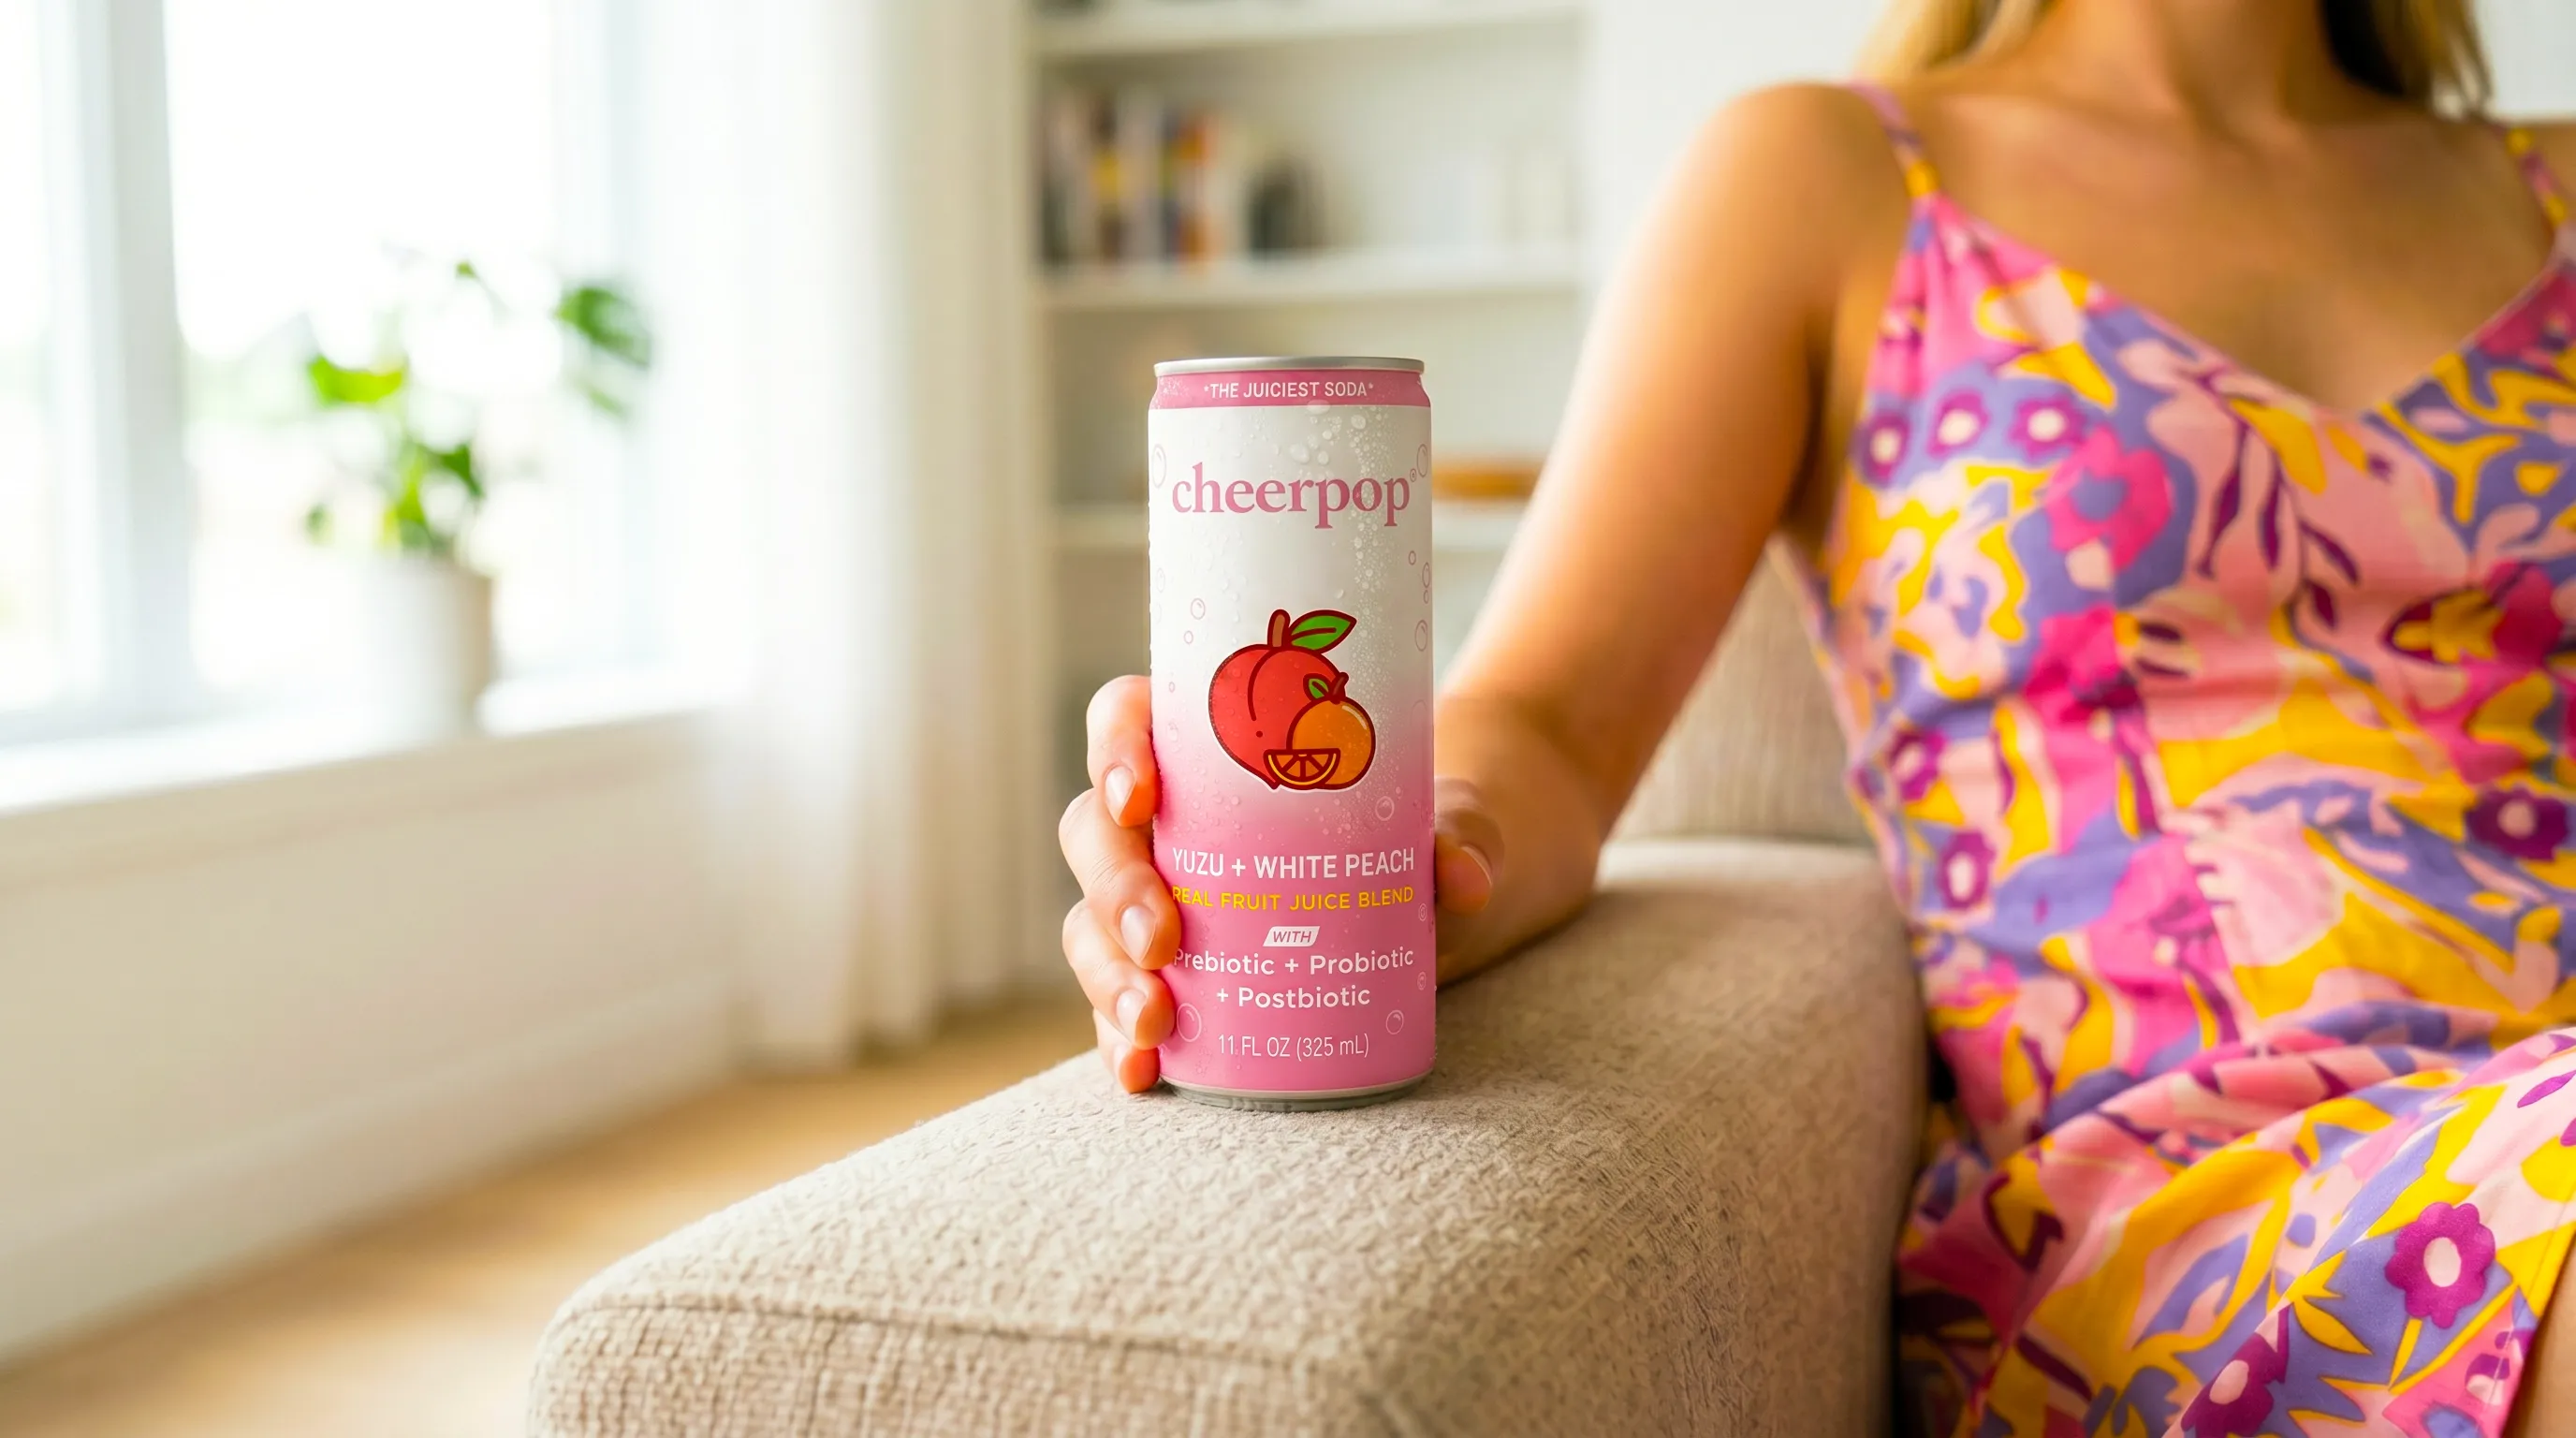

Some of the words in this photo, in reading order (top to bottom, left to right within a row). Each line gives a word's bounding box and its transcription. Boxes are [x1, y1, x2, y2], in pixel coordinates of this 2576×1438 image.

[1243, 382, 1320, 398] JUICIEST
[1172, 847, 1224, 877] YUZU
[1231, 858, 1246, 877] +
[1253, 855, 1338, 878] WHITE
[1345, 847, 1414, 876] PEACH
[1172, 886, 1214, 907] REAL
[1221, 892, 1281, 911] FRUIT
[1289, 892, 1351, 911] JUICE
[1358, 886, 1414, 908] BLEND
[1272, 931, 1312, 943] WITH
[1174, 947, 1275, 976] Prebiotic
[1284, 958, 1299, 973] +
[1310, 946, 1414, 976] Probiotic
[1217, 988, 1229, 1003] +
[1238, 985, 1370, 1009] Postbiotic
[1218, 1034, 1235, 1055] 11
[1241, 1036, 1261, 1056] FL
[1266, 1037, 1291, 1057] OZ
[1296, 1036, 1334, 1062] (325
[1339, 1033, 1369, 1058] mL)
